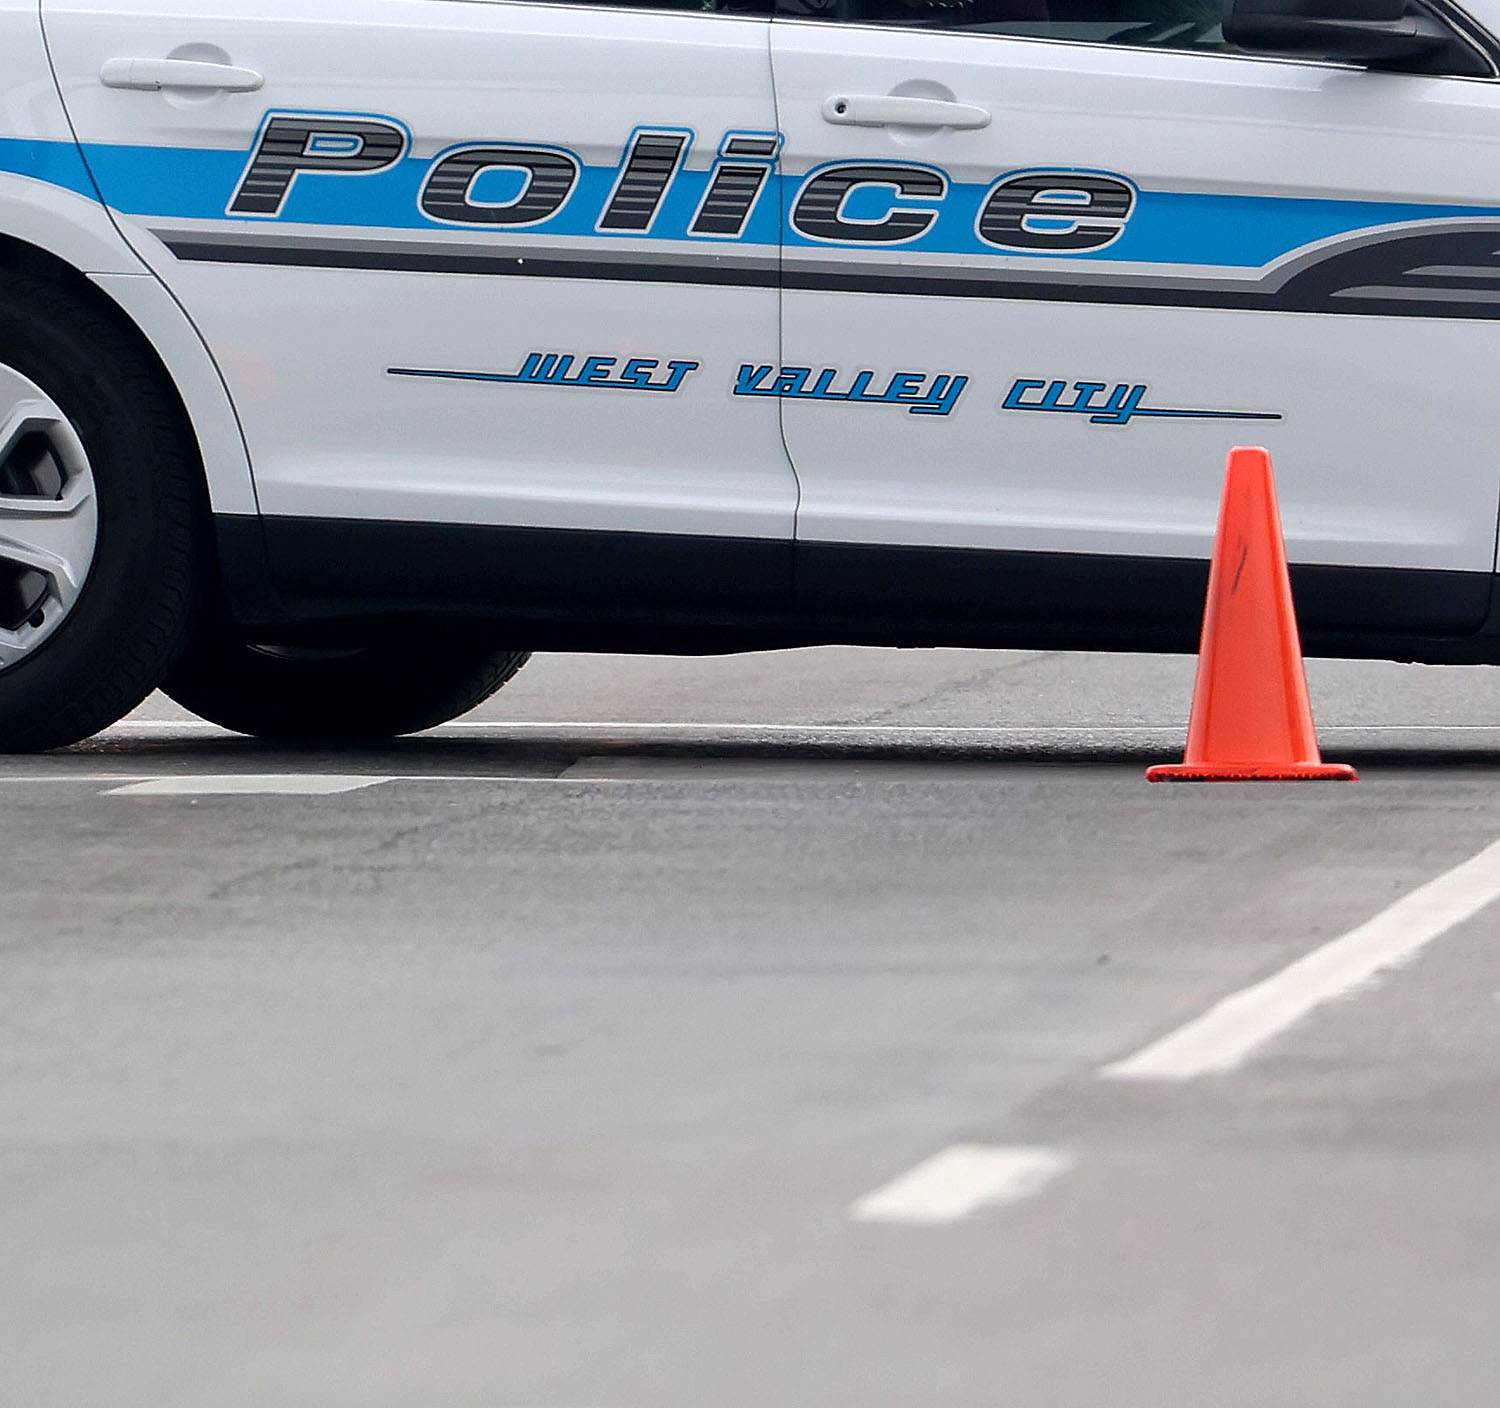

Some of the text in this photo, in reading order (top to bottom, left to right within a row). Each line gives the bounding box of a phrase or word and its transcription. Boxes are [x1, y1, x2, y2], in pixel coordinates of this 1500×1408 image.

[224, 107, 1140, 256] Police
[516, 352, 698, 392] WEST
[1000, 377, 1147, 426] CITY
